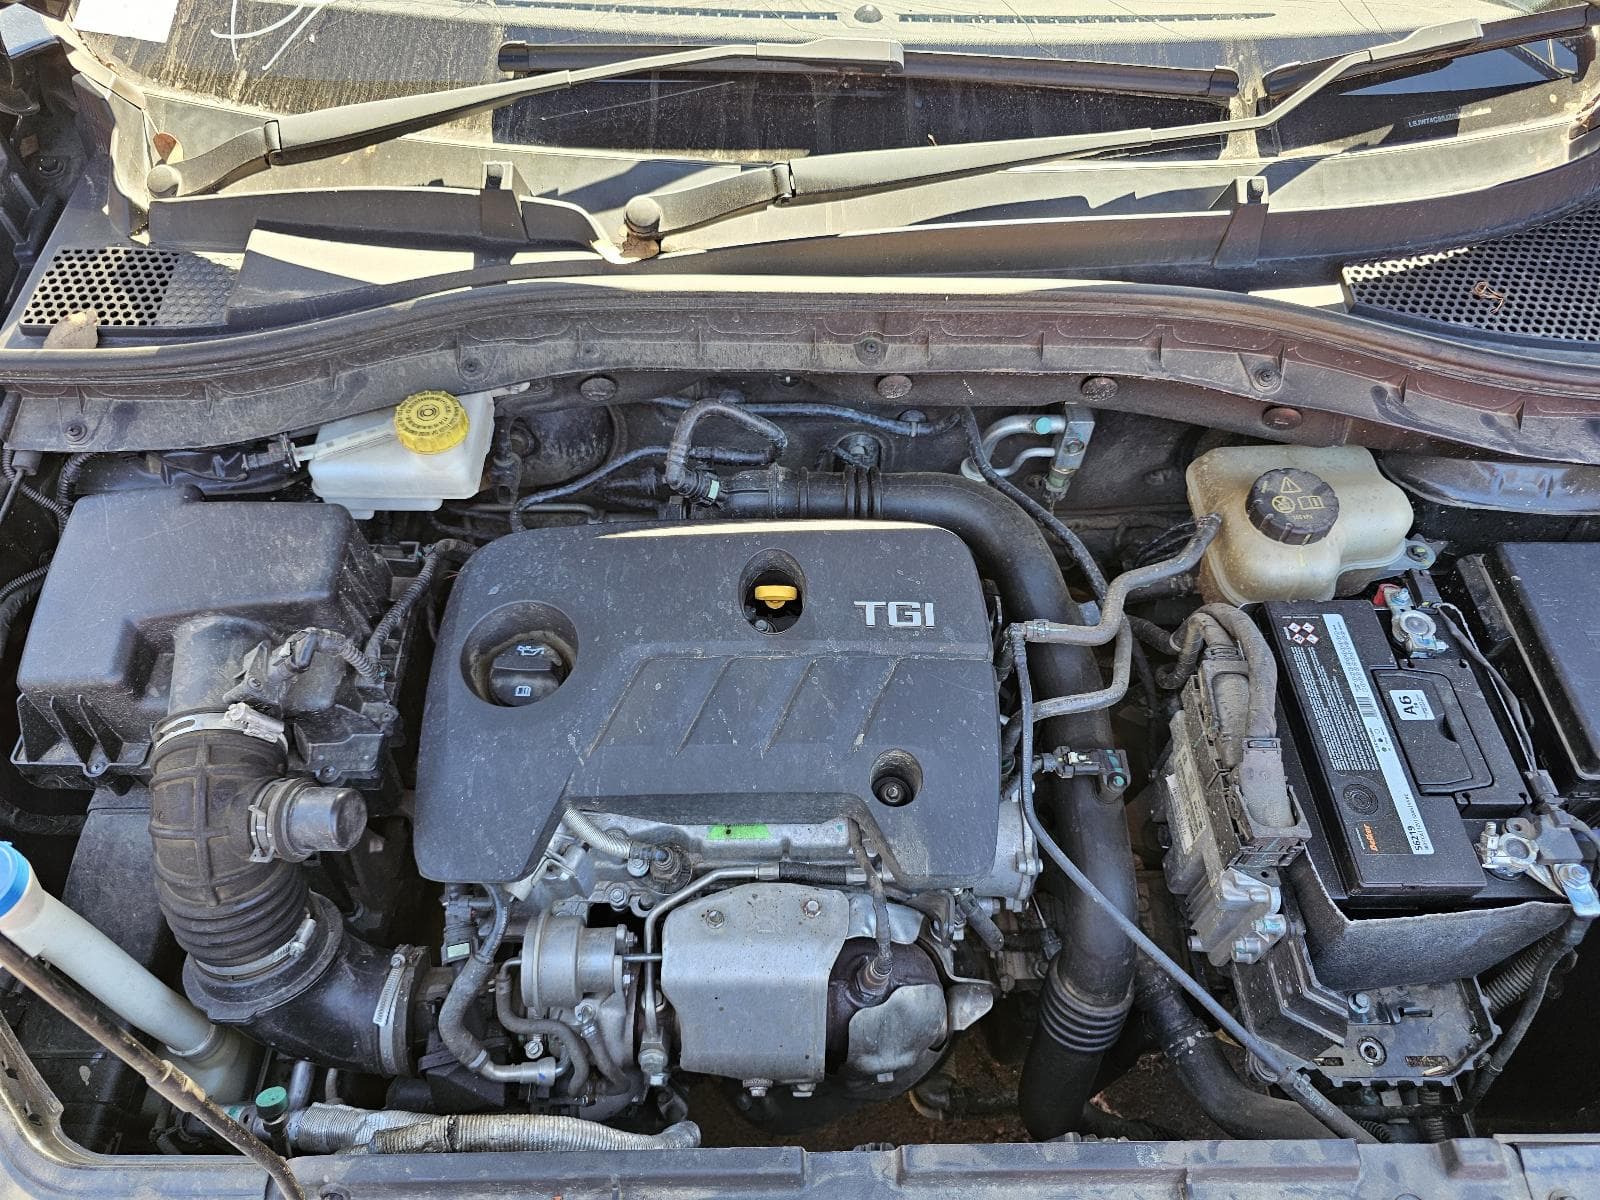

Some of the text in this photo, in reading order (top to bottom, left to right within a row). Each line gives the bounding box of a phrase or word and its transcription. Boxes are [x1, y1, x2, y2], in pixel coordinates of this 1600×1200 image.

[853, 600, 935, 627] TGI
[1399, 695, 1417, 715] A6
[1407, 825, 1422, 851] 56219
